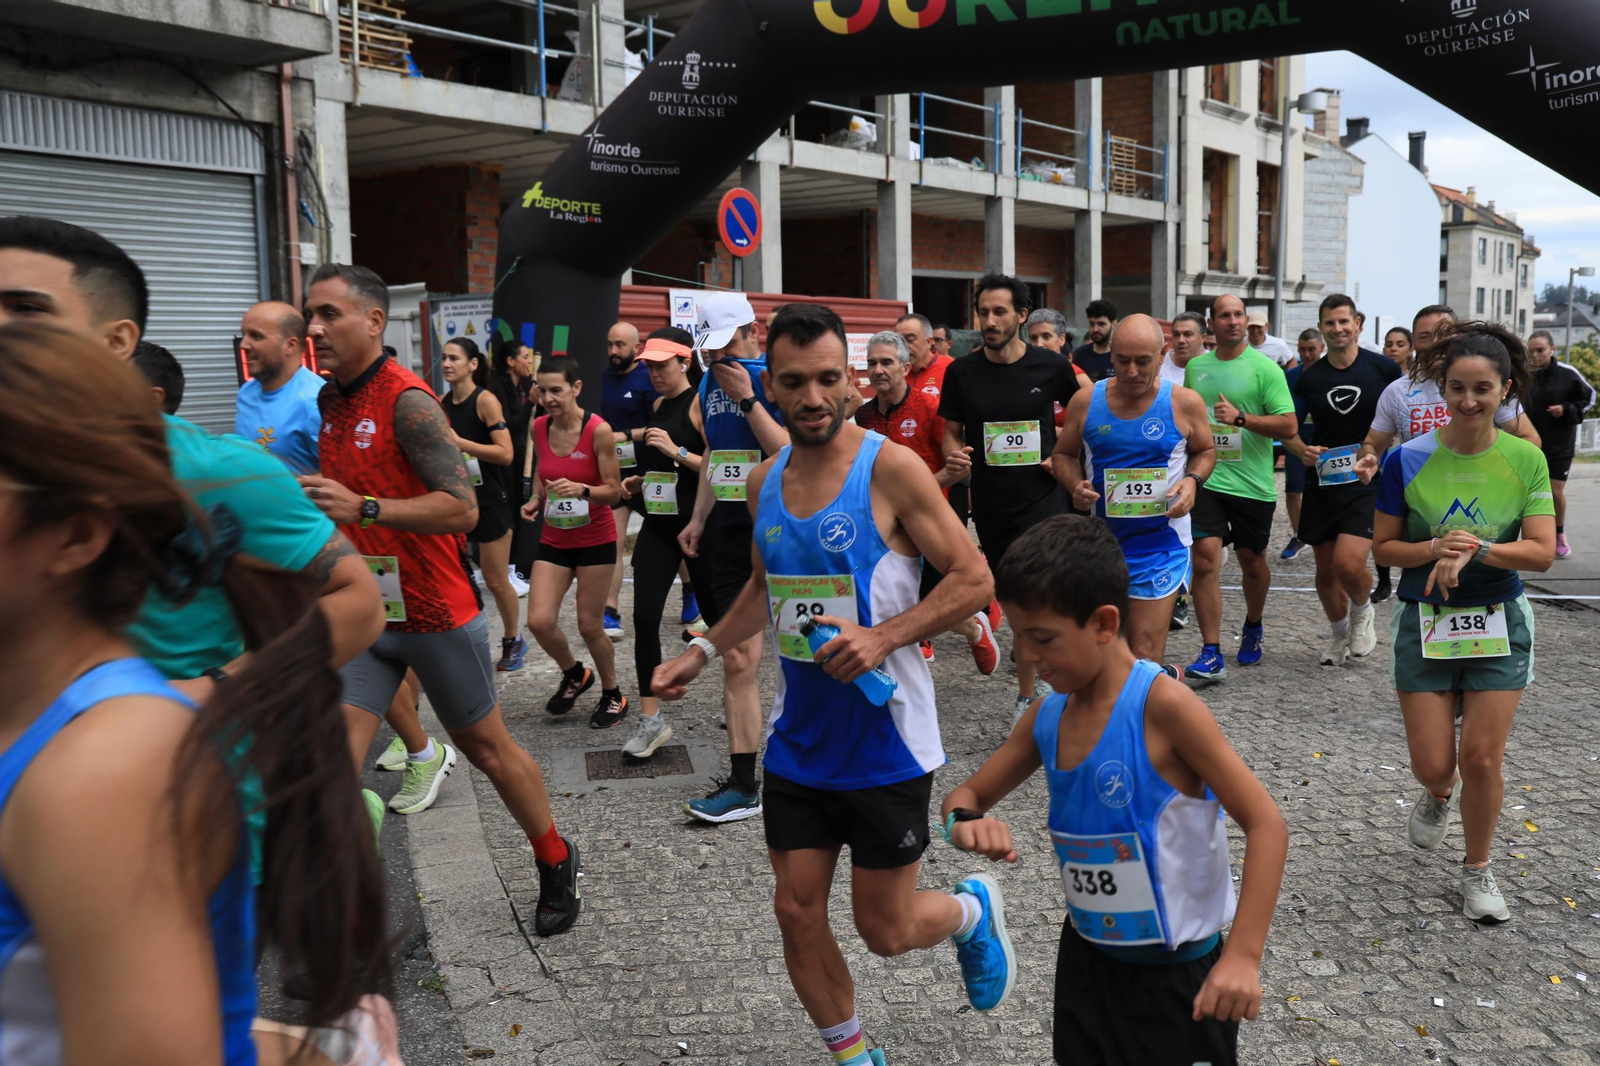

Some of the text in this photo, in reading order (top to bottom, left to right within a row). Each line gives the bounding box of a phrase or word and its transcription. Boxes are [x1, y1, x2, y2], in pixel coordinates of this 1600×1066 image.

[1405, 9, 1530, 46] DEPUTACIÓN
[1424, 29, 1515, 57] OURENSE
[649, 91, 738, 105] DEPUTACIÓN
[658, 105, 726, 118] OURENSE
[592, 140, 641, 158] inorde
[590, 161, 680, 175] turismo Ourense
[550, 210, 563, 220] La
[1006, 435, 1024, 446] 90
[1330, 457, 1351, 469] 333
[724, 466, 740, 478] 53
[655, 485, 662, 495] 8
[1126, 483, 1152, 496] 193
[557, 501, 572, 512] 43
[1450, 615, 1485, 631] 138
[1069, 868, 1117, 896] 338
